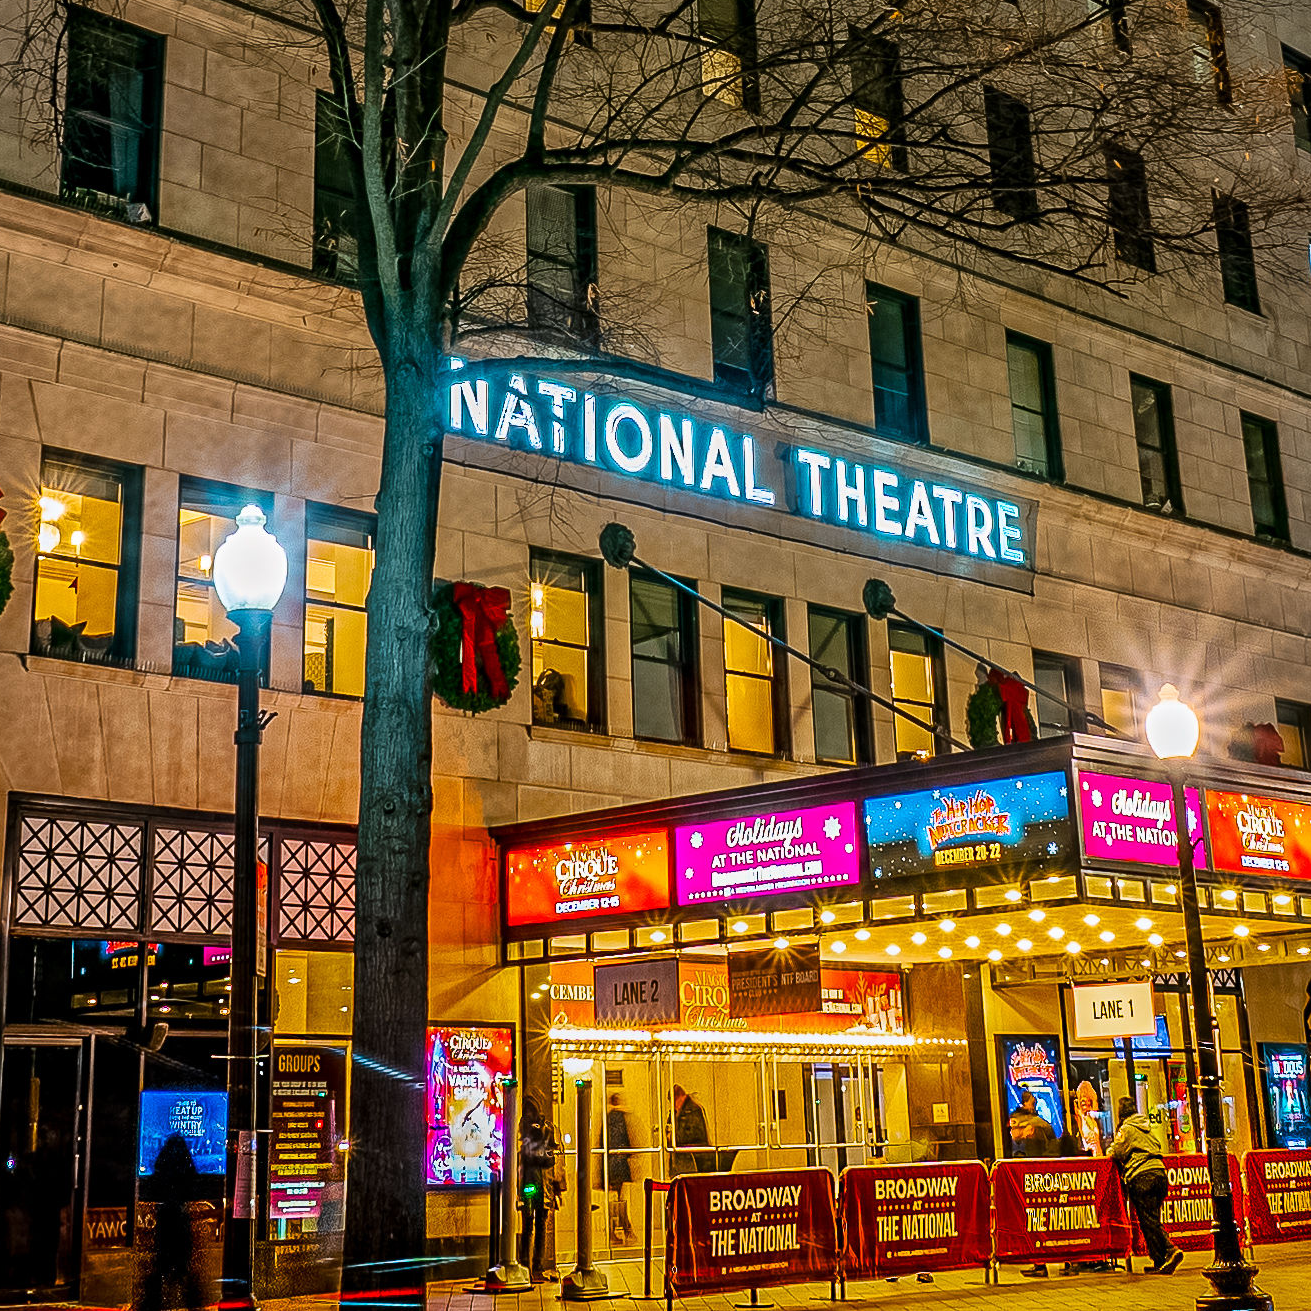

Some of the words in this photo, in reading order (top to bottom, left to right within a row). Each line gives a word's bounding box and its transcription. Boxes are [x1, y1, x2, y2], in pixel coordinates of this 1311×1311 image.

[449, 372, 776, 506] NATIONAL
[796, 448, 1025, 564] THEATRE
[1112, 789, 1172, 829] Holidays
[726, 815, 803, 852] Holidays
[926, 813, 1011, 849] NUTCRACKER
[1092, 821, 1107, 839] AT
[1109, 823, 1135, 842] THE
[1136, 826, 1178, 847] NATION
[1236, 810, 1285, 837] CIRQUE
[711, 854, 727, 868] AT
[730, 850, 754, 866] THE
[757, 842, 822, 863] NATIONAL
[935, 847, 974, 866] DECEMBER
[555, 856, 619, 881] CIRQUE
[560, 877, 616, 897] Christmas
[695, 970, 728, 988] MAGIC
[732, 974, 778, 991] PRESIDENT'S
[795, 970, 819, 985] BOARD
[550, 984, 594, 1001] CEMBE
[614, 981, 647, 1006] LANE
[650, 979, 659, 1003] 2
[680, 980, 729, 1013] CIRQ
[1093, 1000, 1124, 1020] LANE
[1128, 999, 1134, 1017] 1
[450, 1035, 492, 1052] CIRQUE
[278, 1054, 321, 1073] GROUPS
[875, 1176, 958, 1199] BROADWAY
[1025, 1171, 1096, 1193] BROADWAY
[1167, 1167, 1211, 1186] OADWA
[710, 1185, 802, 1211] BROADWAY
[912, 1200, 922, 1211] AT
[1266, 1193, 1284, 1214] THE
[751, 1212, 762, 1223] AT
[1026, 1207, 1048, 1232] THE
[1049, 1205, 1101, 1231] NATIONAL
[1160, 1200, 1173, 1224] HE
[1173, 1198, 1214, 1222] NATIONA
[876, 1215, 900, 1242] THE
[902, 1212, 958, 1241] NATIONAL
[710, 1229, 736, 1257] THE
[739, 1223, 800, 1255] NATIONAL
